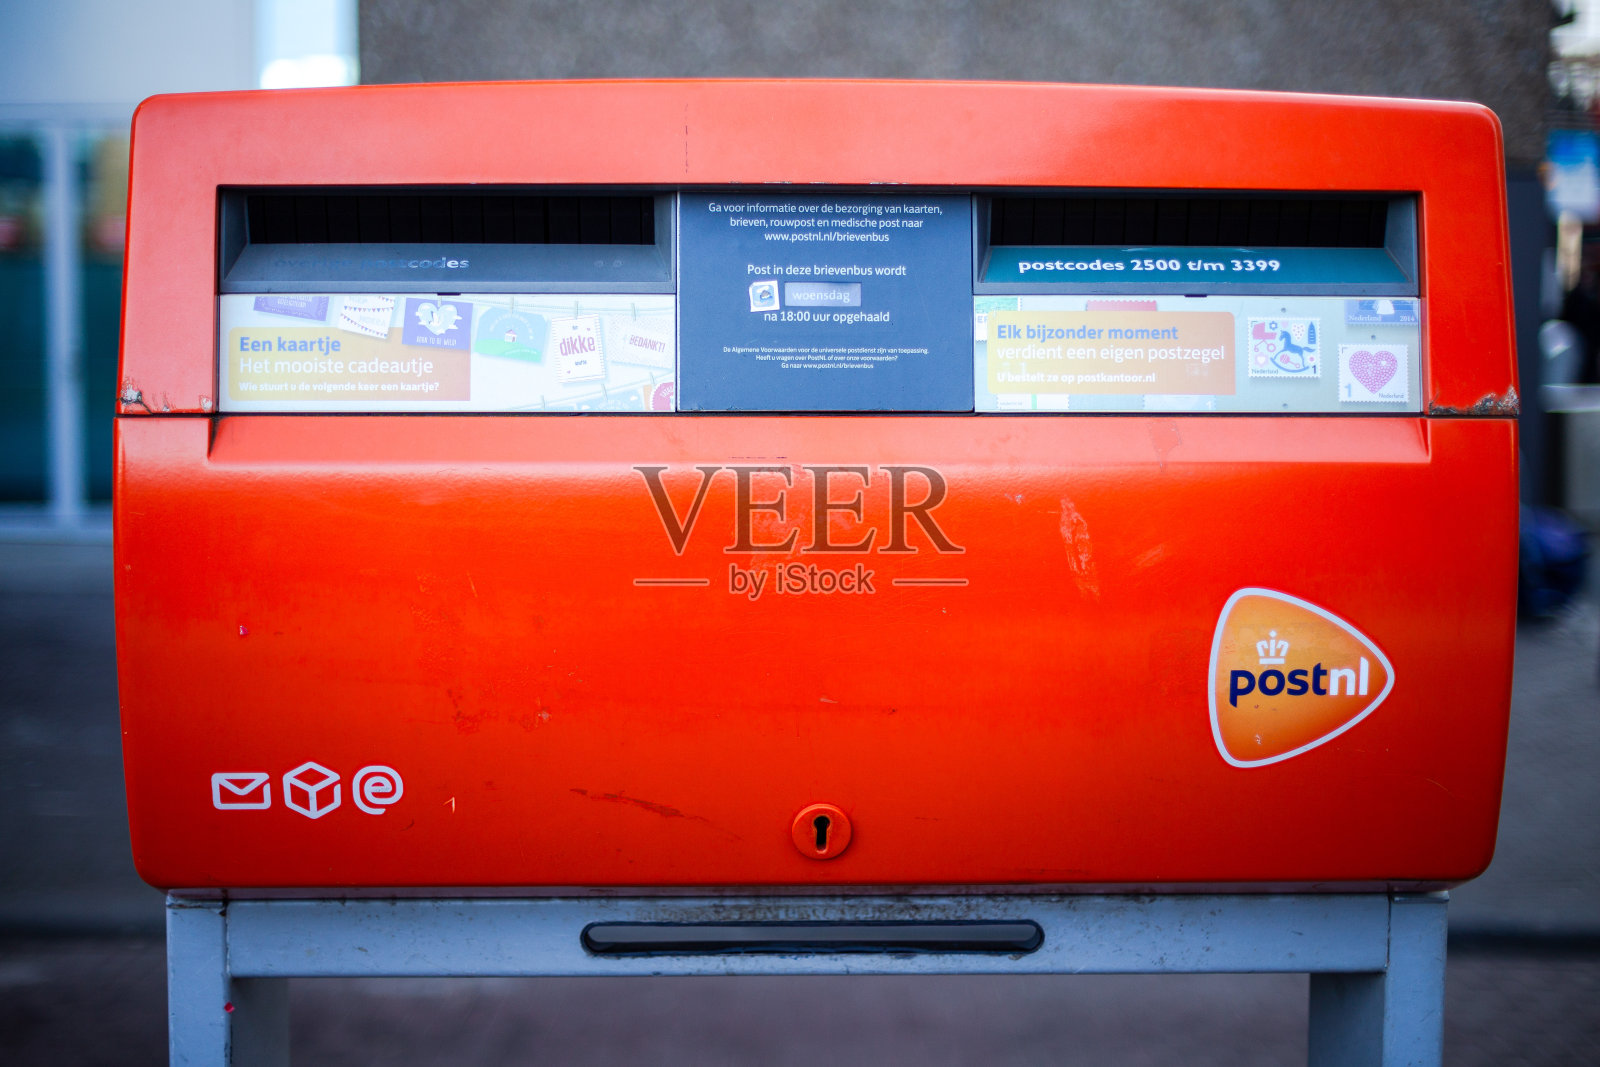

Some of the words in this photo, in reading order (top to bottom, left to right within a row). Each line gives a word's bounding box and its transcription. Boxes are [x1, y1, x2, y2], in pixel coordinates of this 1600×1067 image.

[708, 203, 722, 212] Ga
[747, 203, 796, 213] informatie
[798, 205, 819, 213] over
[821, 204, 833, 213] de
[835, 204, 883, 216] bezorging
[903, 204, 943, 215] kaarten,
[730, 217, 768, 228] brieven,
[770, 218, 815, 229] rouwpost
[817, 219, 829, 227] en
[831, 218, 877, 227] medische
[879, 219, 900, 229] post
[902, 220, 923, 228] naar
[764, 232, 889, 243] www.postnl.nl/brievenbus
[747, 264, 771, 275] Post
[773, 264, 783, 275] in
[785, 265, 811, 275] deze
[814, 265, 873, 276] brievenbus
[875, 265, 906, 276] wordt
[1018, 259, 1125, 274] postcodes
[1130, 259, 1181, 271] 2500
[1187, 260, 1225, 271] t/m
[1231, 260, 1280, 271] 3399
[791, 290, 850, 304] woensdag
[764, 313, 778, 321] na
[780, 311, 810, 321] 18:00
[833, 311, 890, 324] opgehaald
[1348, 314, 1382, 322] Nederland
[997, 325, 1021, 339] Elk
[1026, 325, 1104, 343] bijzonder
[1108, 326, 1179, 340] moment
[239, 336, 272, 352] Een
[277, 336, 341, 356] kaartje
[559, 335, 596, 356] dikke
[628, 334, 666, 353] BEDANKT!
[732, 346, 760, 354] Algemene
[996, 345, 1063, 360] verdient
[1066, 347, 1096, 359] een
[1100, 344, 1144, 363] eigen
[1148, 345, 1224, 364] postzegel
[240, 358, 270, 373] Het
[274, 358, 344, 374] mooiste
[348, 357, 433, 377] cadeautje
[1311, 364, 1317, 374] 1
[997, 373, 1004, 382] U
[1006, 372, 1045, 382] bestelt
[1047, 374, 1059, 382] ze
[1061, 374, 1075, 384] op
[1077, 372, 1156, 384] postkantoor.nl
[240, 382, 258, 391] Wie
[259, 382, 288, 391] stuurt
[298, 381, 310, 391] de
[312, 382, 356, 393] volgende
[358, 381, 379, 391] keer
[380, 383, 399, 391] een
[400, 381, 440, 393] kaartje?
[1344, 383, 1352, 398] 1
[1229, 656, 1369, 708] postnl
